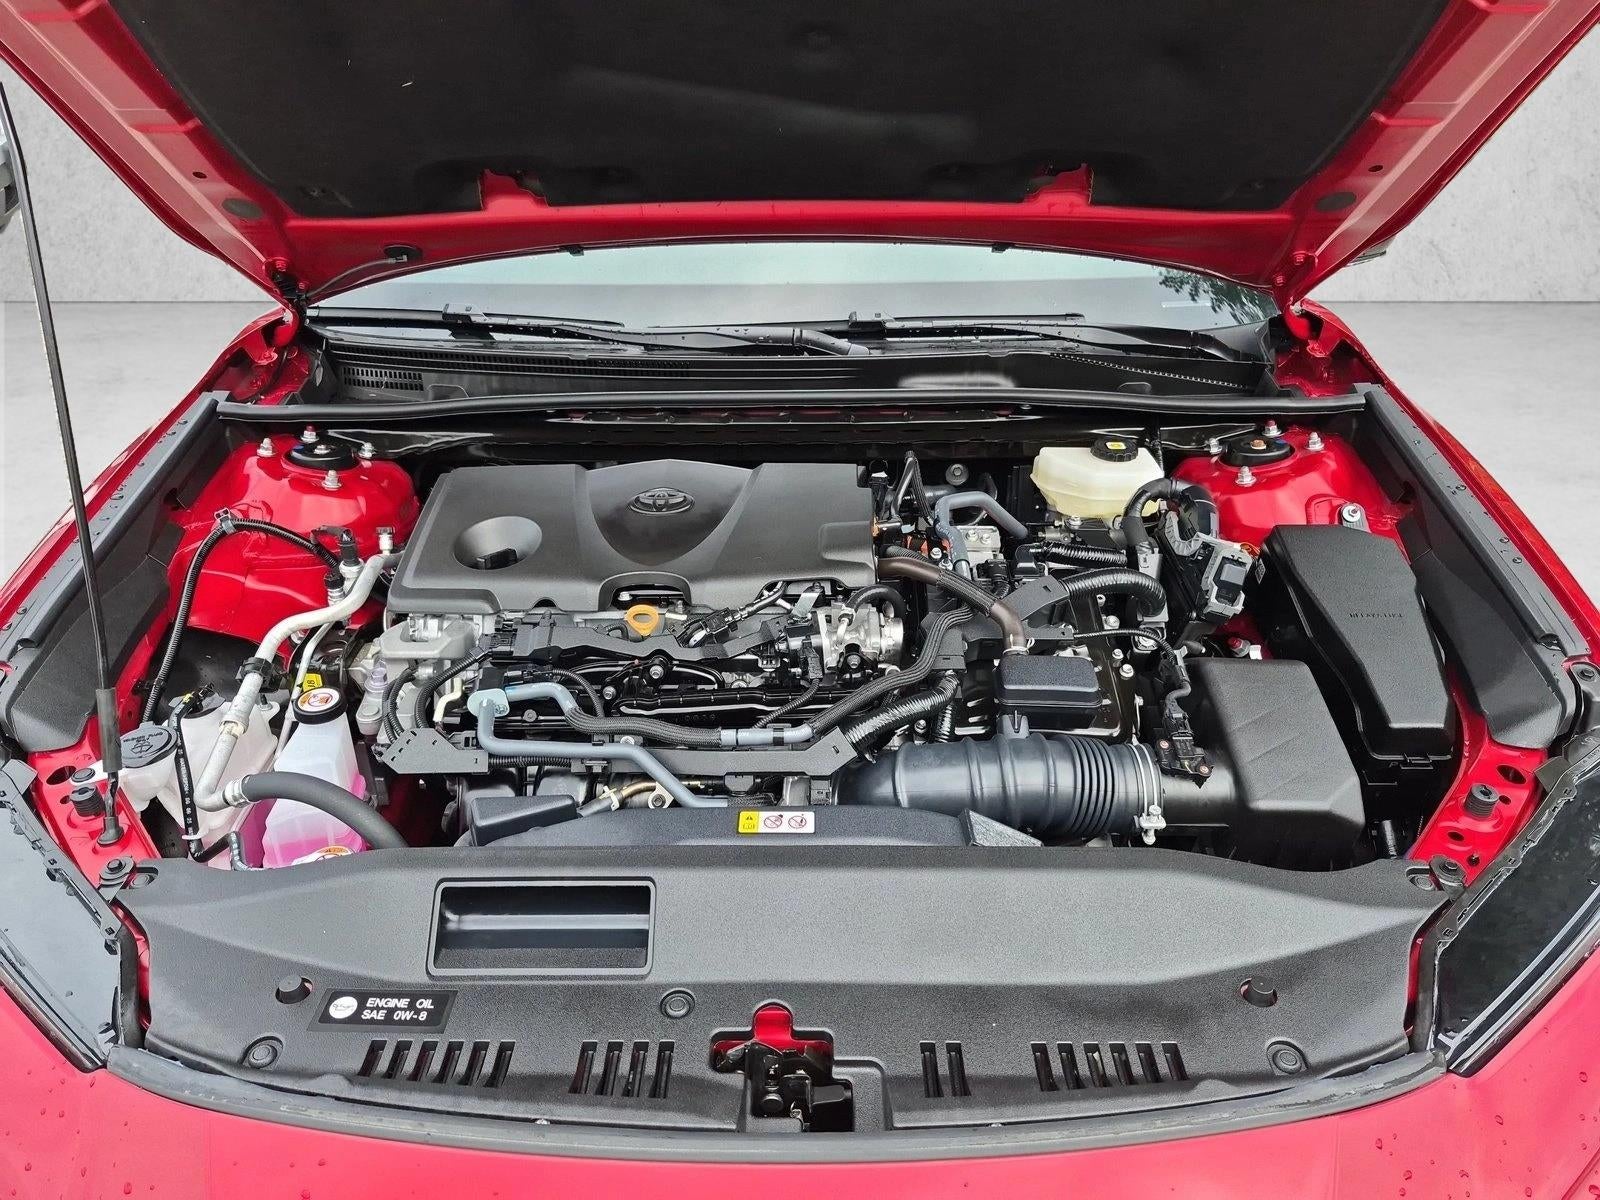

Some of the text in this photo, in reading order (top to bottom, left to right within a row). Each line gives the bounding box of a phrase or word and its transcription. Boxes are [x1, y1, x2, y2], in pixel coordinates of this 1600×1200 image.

[366, 997, 434, 1009] ENGINE OIL
[361, 1009, 428, 1021] SAE 0W-8
